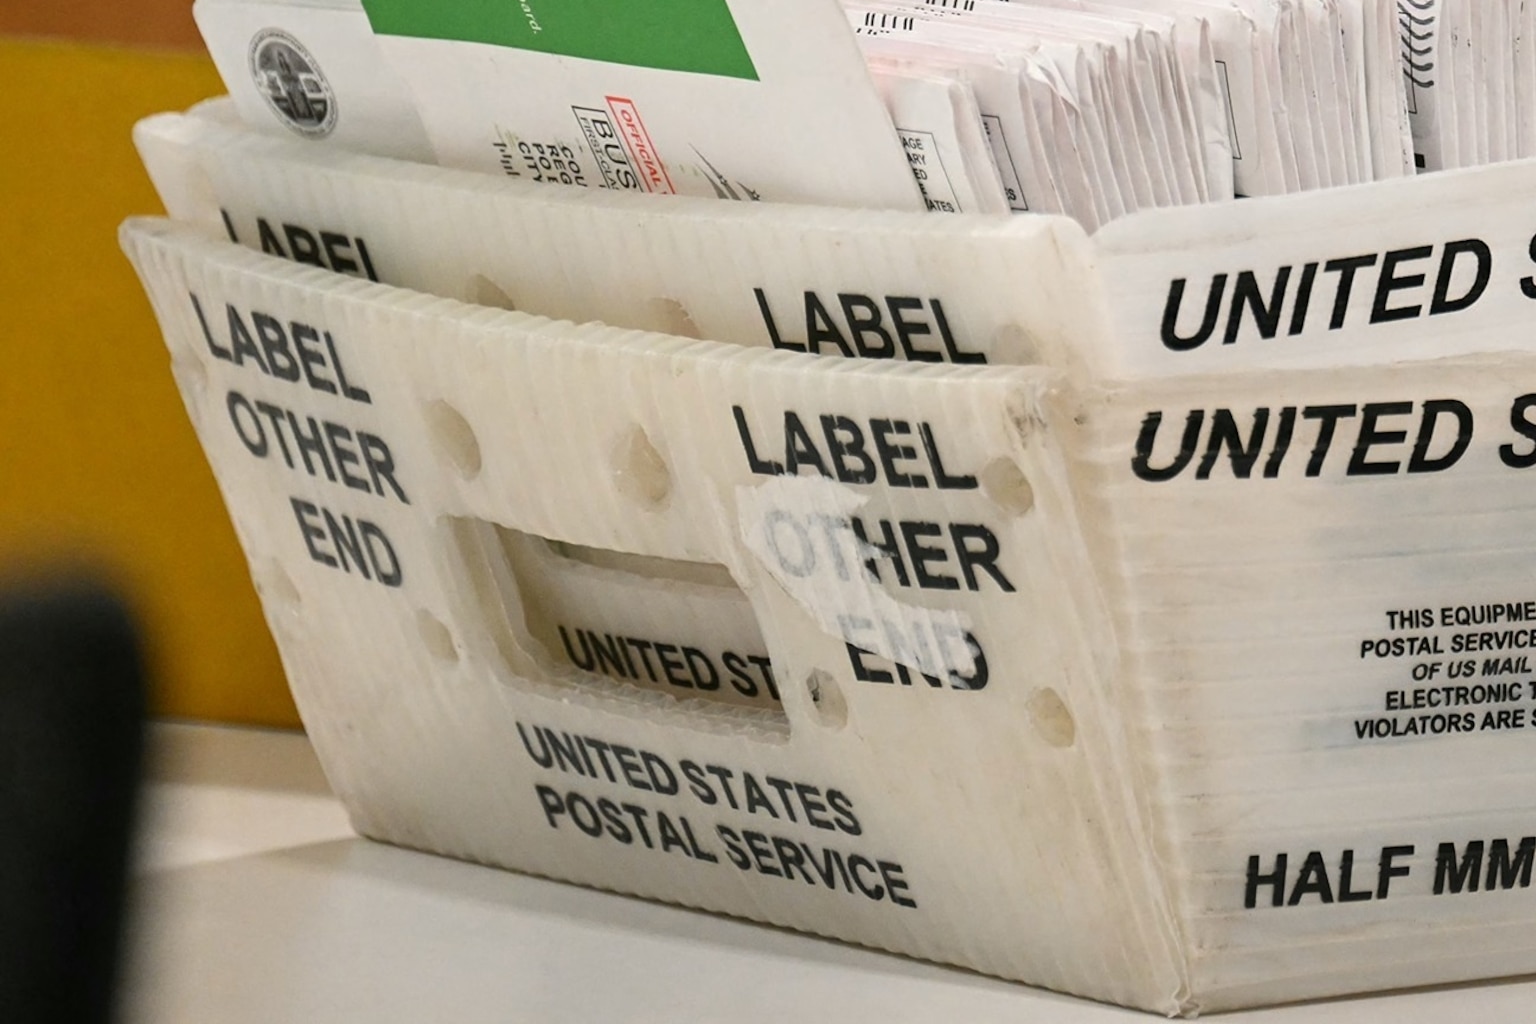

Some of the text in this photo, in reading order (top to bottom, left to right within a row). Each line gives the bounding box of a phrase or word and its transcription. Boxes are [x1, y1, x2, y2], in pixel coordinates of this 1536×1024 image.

[517, 141, 544, 184] CITY
[620, 108, 663, 188] OFFICIAL
[752, 287, 988, 365] LABEL
[1159, 237, 1492, 351] UNITED
[188, 291, 373, 405] LABEL
[226, 390, 412, 506] OTHER
[731, 404, 979, 491] LABEL
[1130, 398, 1474, 482] UNITED
[288, 495, 404, 589] END
[763, 509, 1017, 594] OTHER
[557, 624, 722, 692] UNITED
[836, 612, 990, 692] END
[1360, 635, 1444, 658] POSTAL
[1385, 608, 1434, 630] THIS
[1385, 681, 1522, 711] ELECTRONIC
[1411, 661, 1442, 681] OF
[1447, 659, 1476, 679] US
[1481, 656, 1532, 676] MAIL
[1354, 711, 1475, 739] VIOLATORS
[1479, 708, 1525, 731] ARE
[515, 721, 862, 836] UNITED STATES
[534, 783, 918, 909] POSTAL SERVICE
[1243, 843, 1415, 909] HALF
[1431, 835, 1536, 895] MM
